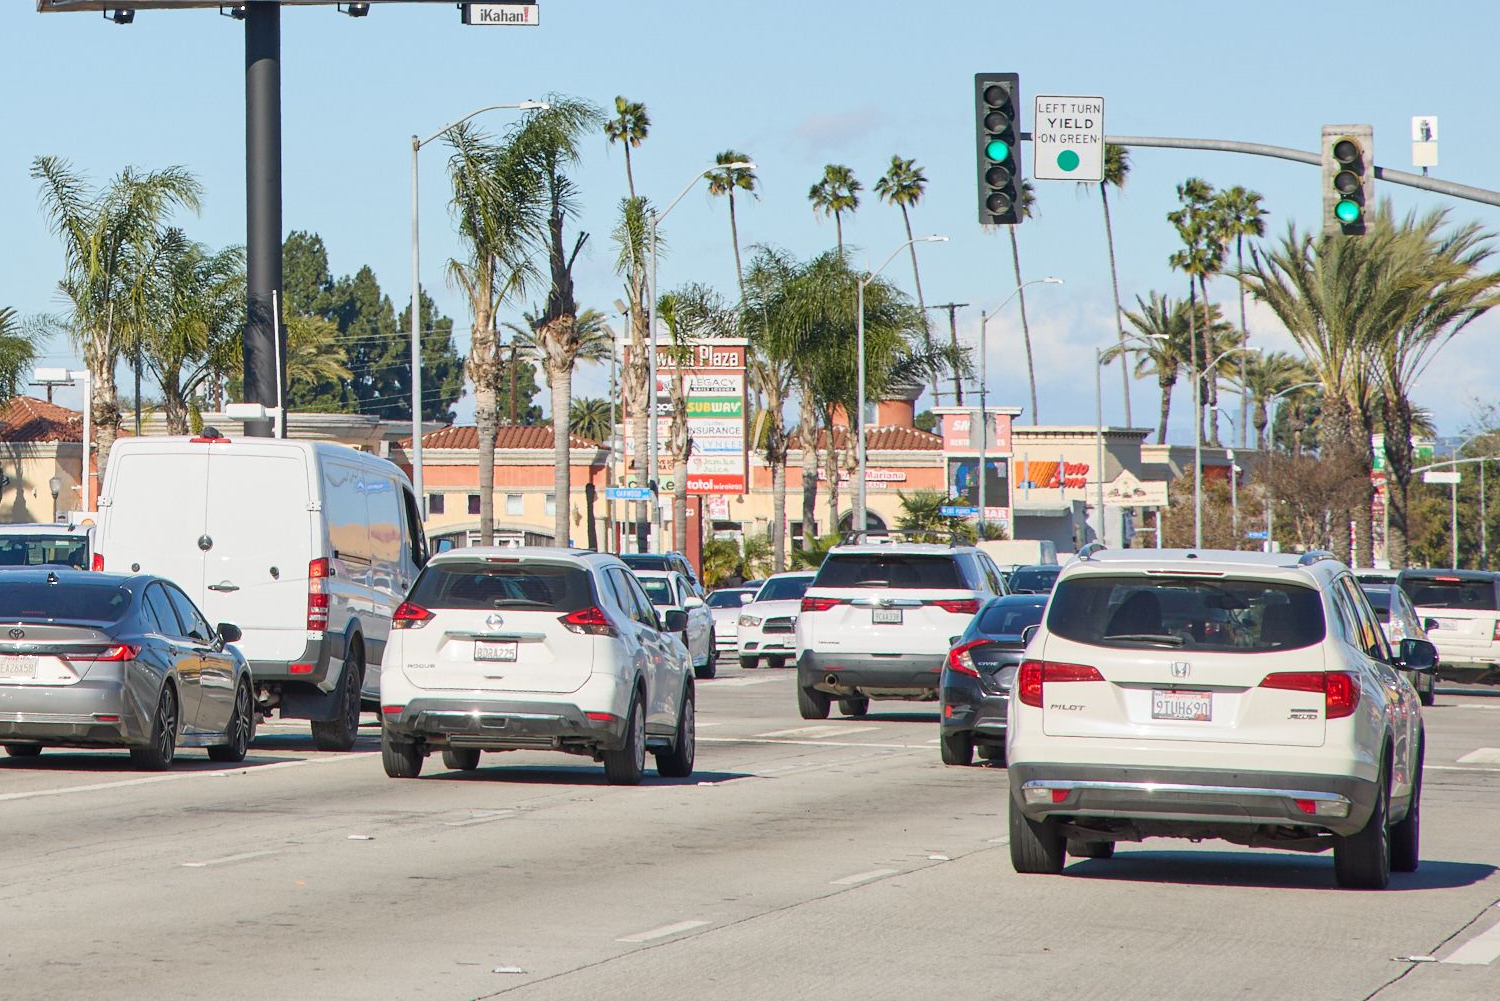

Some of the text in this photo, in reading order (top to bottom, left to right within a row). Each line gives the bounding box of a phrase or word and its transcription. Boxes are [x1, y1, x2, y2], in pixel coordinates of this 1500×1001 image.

[1038, 104, 1100, 114] LEFT TURN
[1048, 118, 1094, 128] YIELD
[1041, 134, 1097, 144] ON GREEN
[700, 346, 738, 366] Plaza
[691, 378, 736, 386] LEGACY
[686, 402, 741, 412] SUBWAY
[1053, 462, 1089, 475] Auto
[687, 480, 712, 490] total
